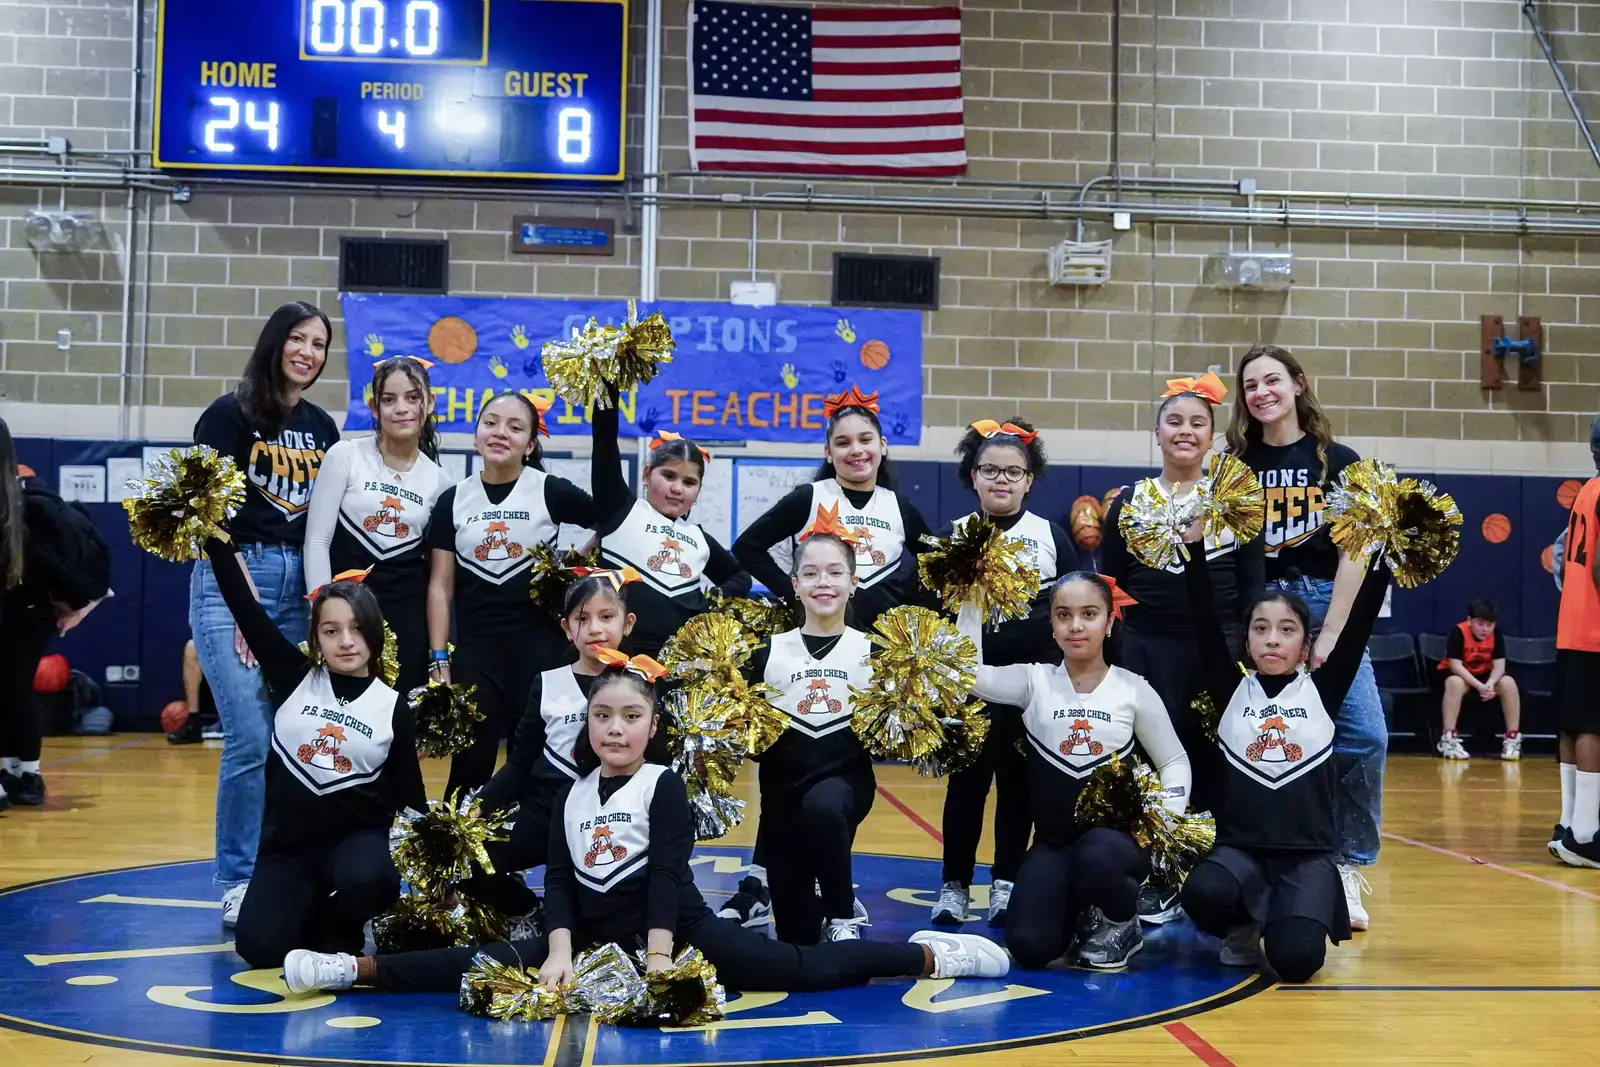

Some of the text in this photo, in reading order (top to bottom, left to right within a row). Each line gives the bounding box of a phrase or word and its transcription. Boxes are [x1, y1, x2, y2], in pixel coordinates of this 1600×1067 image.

[309, 0, 439, 55] 00.0
[201, 61, 277, 88] HOME
[504, 70, 589, 98] GUEST
[361, 82, 424, 100] PERIOD
[205, 97, 281, 153] 24
[377, 110, 406, 149] 4
[557, 107, 592, 163] 8
[665, 389, 838, 429] TEACHE
[248, 440, 325, 507] CHEE
[1258, 468, 1309, 488] IONS
[364, 481, 378, 491] P.S.
[399, 488, 424, 507] CHEER
[466, 514, 480, 524] P.S.
[503, 510, 530, 521] CHEER
[865, 516, 892, 531] CHEER
[1264, 486, 1327, 546] EER
[645, 523, 659, 534] P.S.
[676, 531, 699, 550] CHEER
[1566, 510, 1588, 568] 12
[790, 671, 804, 683] P.S.
[823, 668, 849, 681] CHEER
[301, 705, 319, 716] P.S.
[344, 715, 374, 740] CHEER
[564, 713, 578, 725] P.S.
[1053, 709, 1066, 719] P.S.
[1087, 709, 1112, 722] CHEER
[1243, 706, 1258, 718] P.S.
[580, 820, 592, 833] P.S.
[608, 812, 632, 823] CHEER
